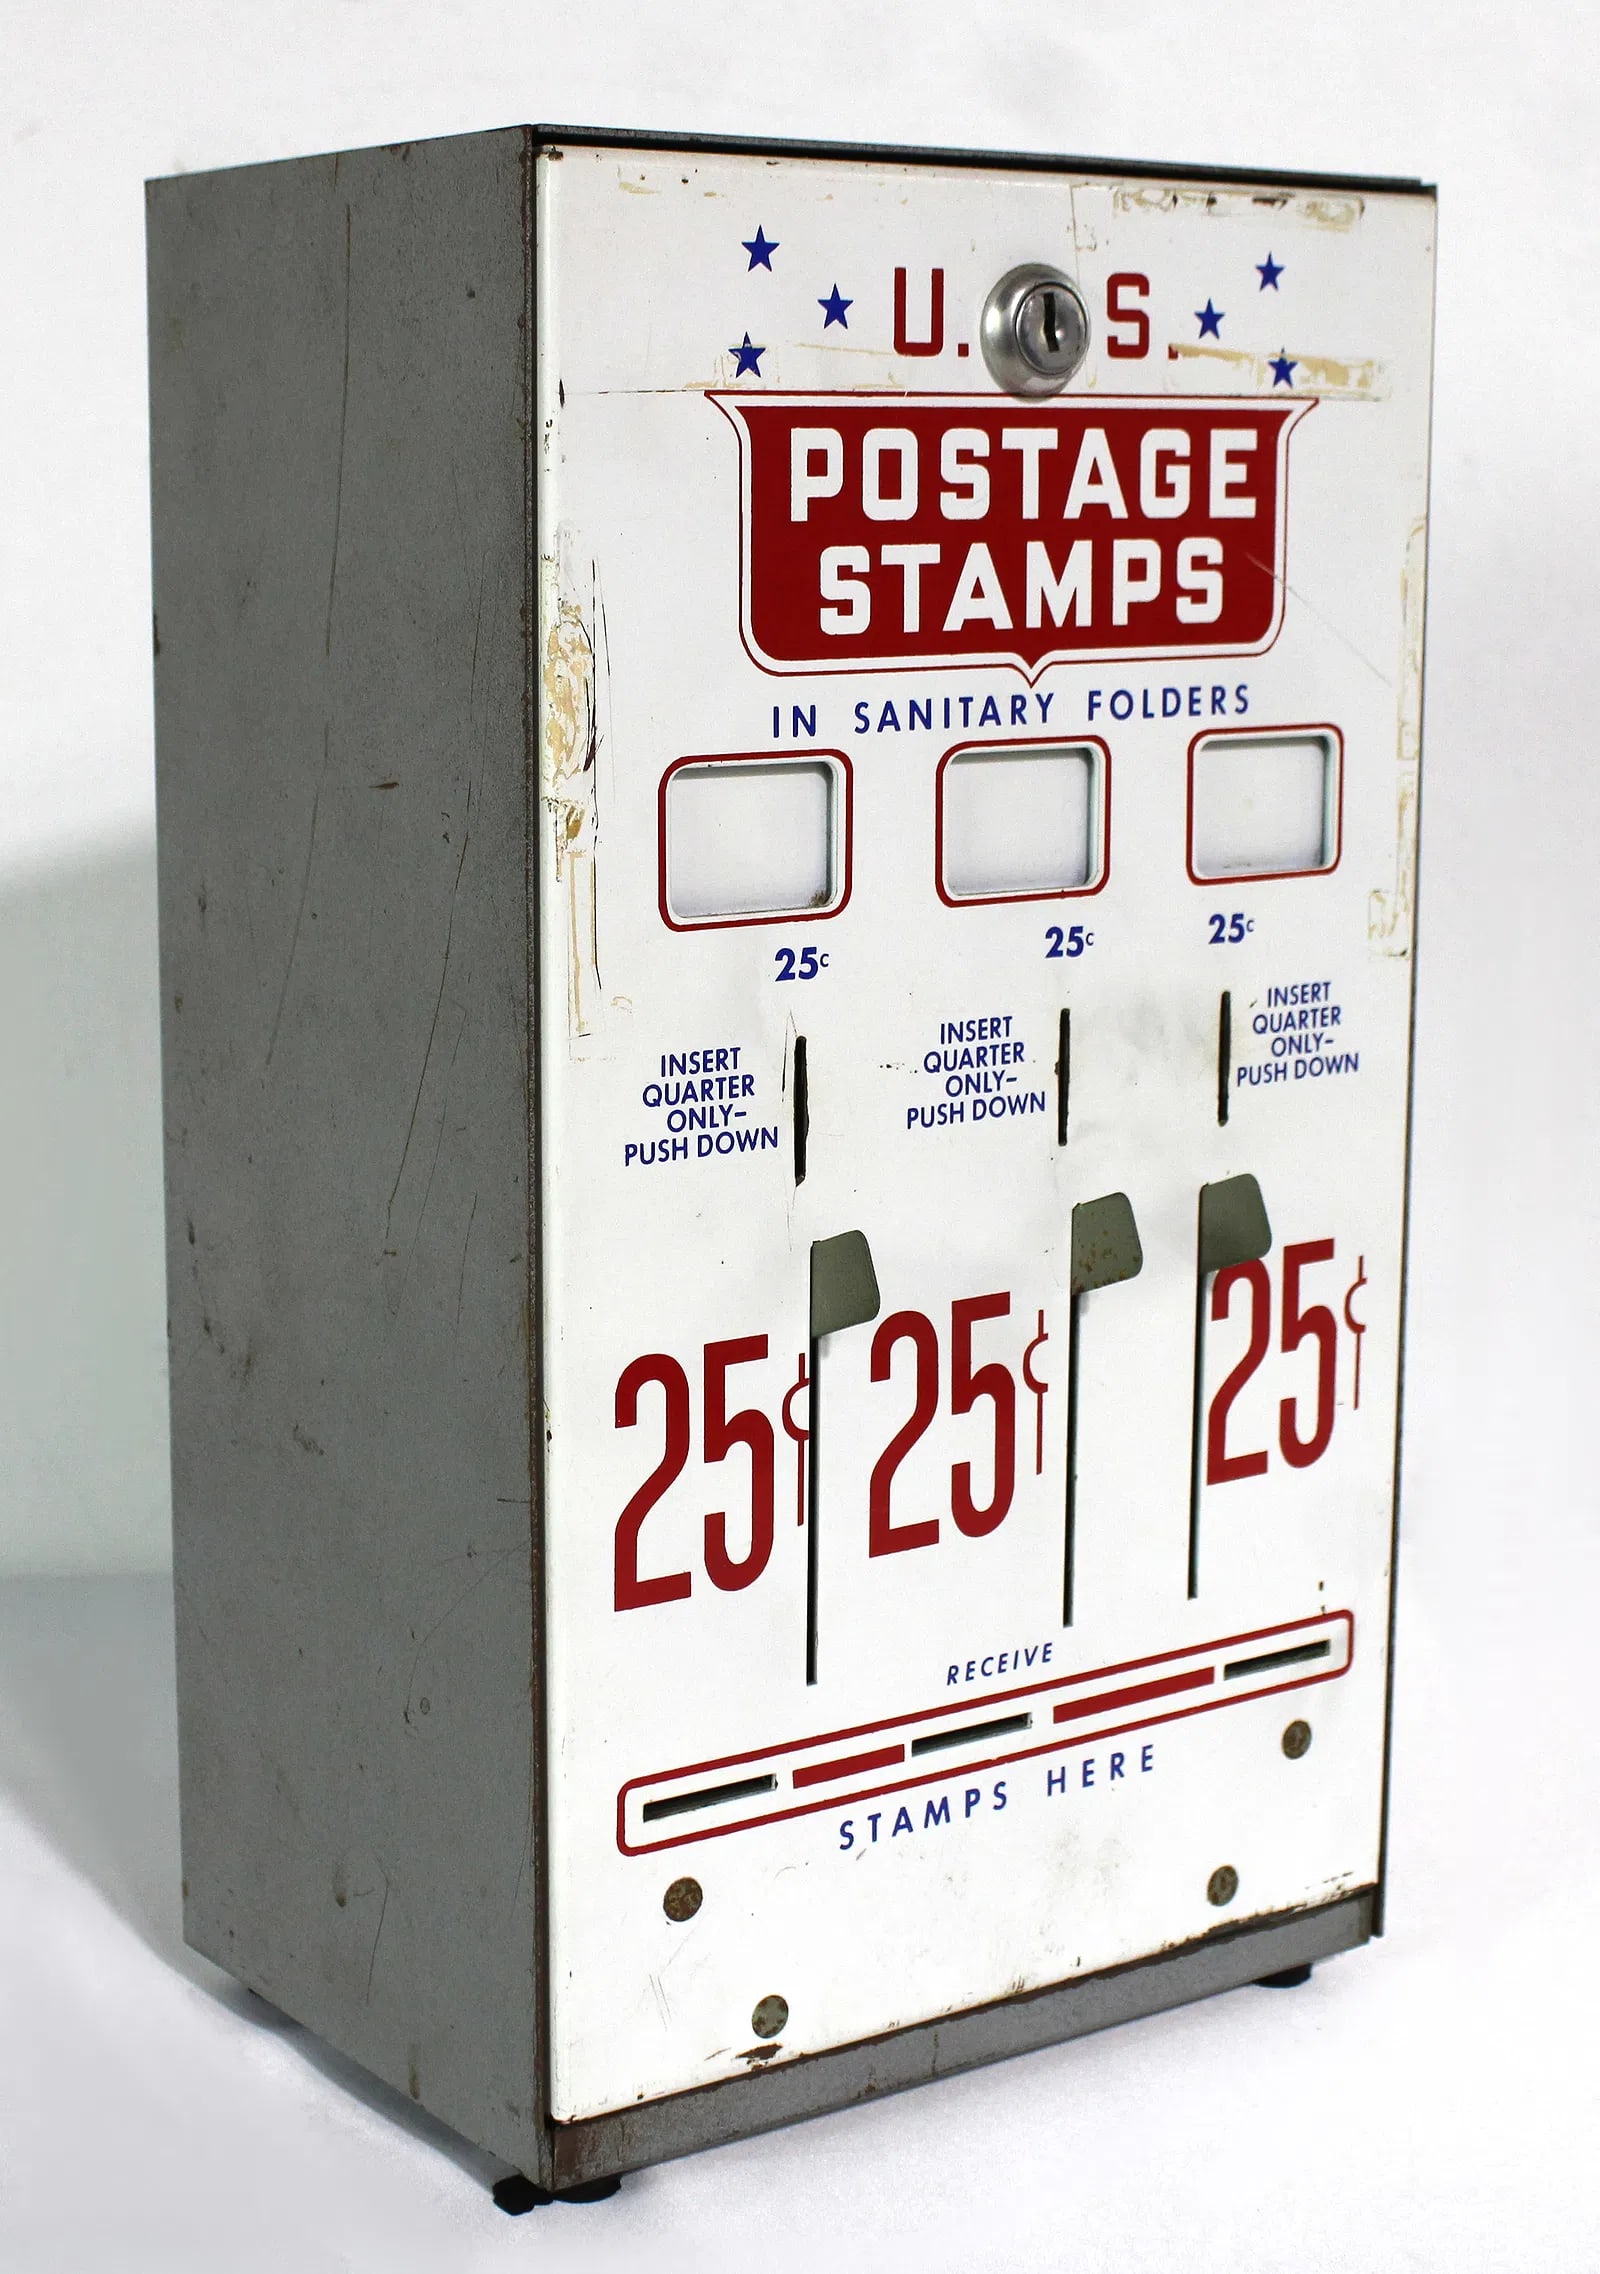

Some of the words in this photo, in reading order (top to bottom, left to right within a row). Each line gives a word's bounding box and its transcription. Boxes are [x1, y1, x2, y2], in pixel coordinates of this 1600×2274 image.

[892, 267, 969, 358] U.
[1106, 273, 1179, 361] S.
[790, 427, 1258, 523] POSTAGE
[820, 536, 1224, 636] STAMPS
[772, 704, 817, 738] IN
[854, 690, 1055, 734] SANITARY
[1088, 683, 1250, 721] FOLDERS
[1267, 981, 1332, 1007] INSERT
[940, 1015, 1013, 1044] INSERT
[1253, 1005, 1343, 1036] QUARTER
[660, 1046, 741, 1076] INSERT
[923, 1041, 1026, 1075] QUARTER
[1237, 1063, 1290, 1087] PUSH
[1294, 1051, 1361, 1080] DOWN
[642, 1074, 755, 1108] QUARTER
[906, 1102, 965, 1130] PUSH
[971, 1091, 1047, 1122] DOWN
[624, 1138, 689, 1167] PUSH
[696, 1127, 779, 1158] DOWN
[946, 1642, 1055, 1686] RECEIVE
[839, 1781, 1009, 1852] STAMPS
[1046, 1743, 1158, 1798] HERE
